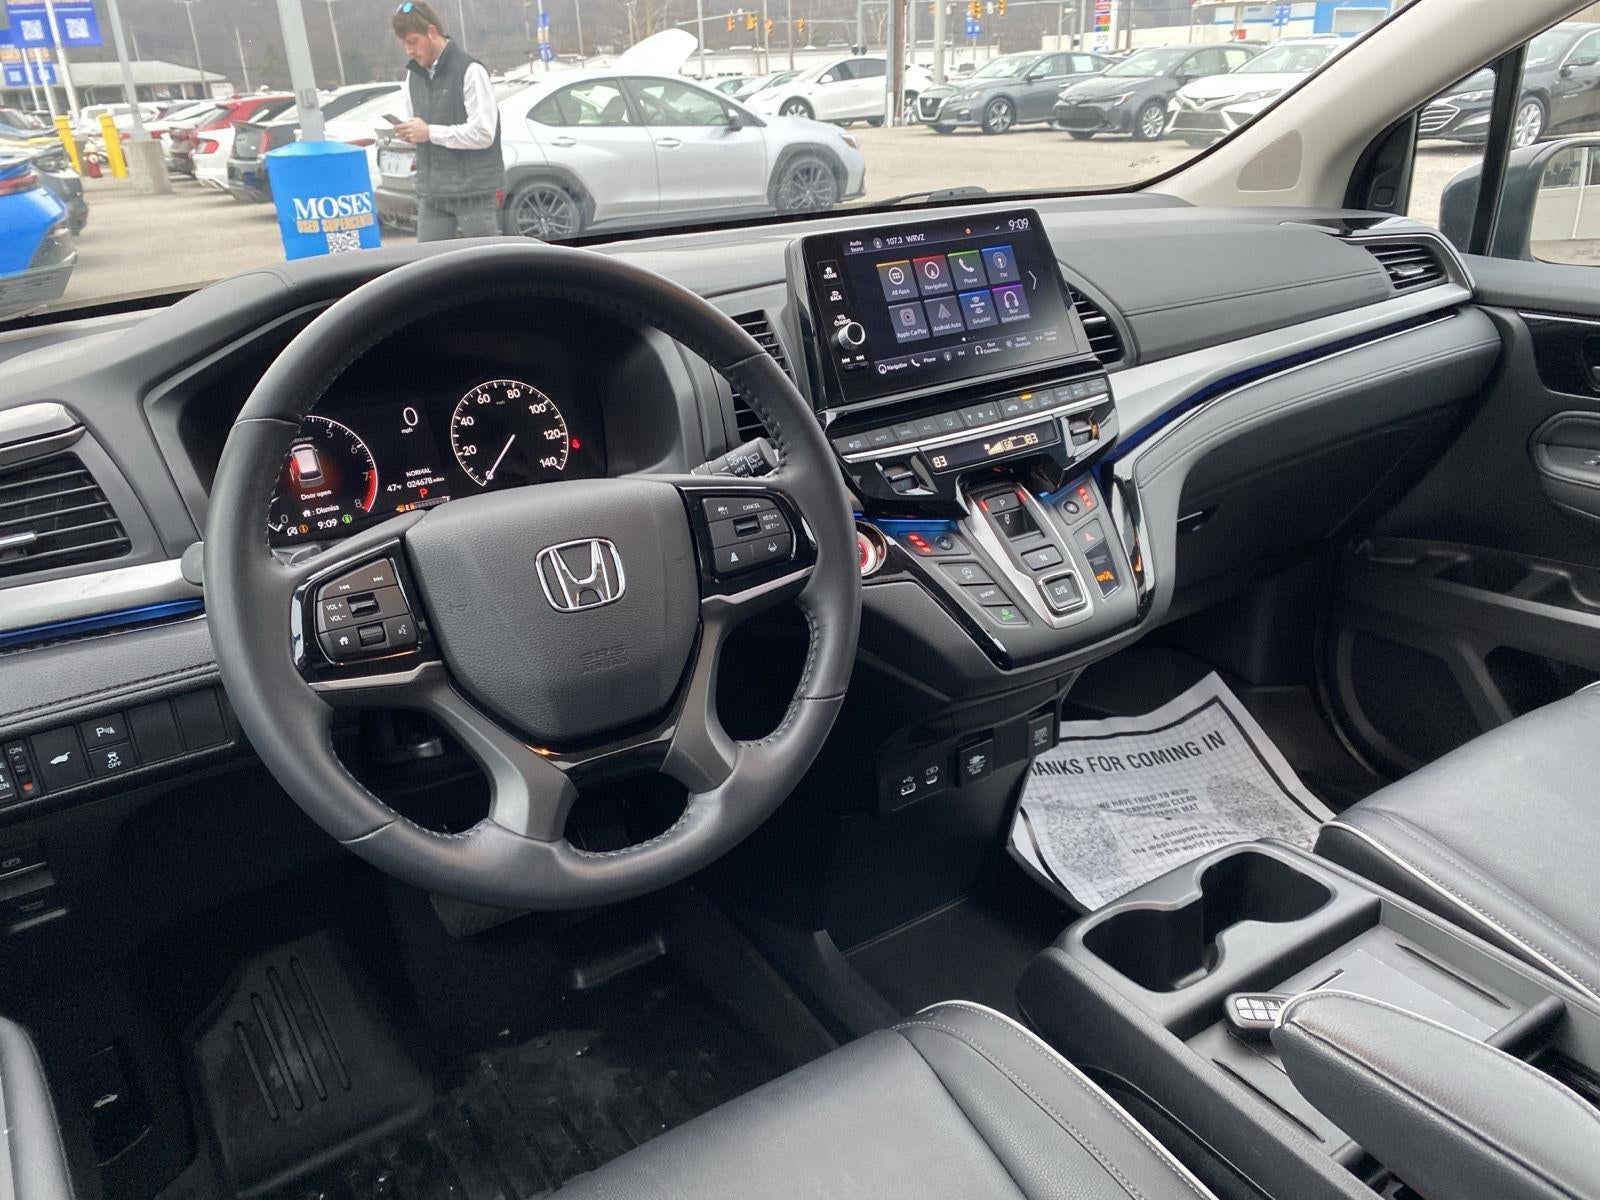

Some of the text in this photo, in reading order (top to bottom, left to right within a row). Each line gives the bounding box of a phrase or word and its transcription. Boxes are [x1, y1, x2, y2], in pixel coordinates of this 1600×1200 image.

[292, 192, 372, 220] MOSES
[1008, 217, 1029, 231] 9:09
[885, 233, 926, 245] 107.3 WRVZ
[925, 282, 949, 291] Navigation
[963, 277, 978, 285] Phone
[899, 288, 910, 296] Apps
[830, 294, 843, 302] BACK
[933, 321, 962, 332] Android Auto
[897, 328, 928, 339] Apple CarPlay
[477, 393, 491, 405] 60
[507, 388, 521, 399] 80
[529, 403, 547, 414] 100
[403, 407, 418, 426] 0
[460, 416, 474, 427] 40
[325, 429, 334, 439] 5
[544, 429, 561, 440] 120
[1024, 432, 1038, 444] 83
[350, 445, 358, 454] 6
[462, 444, 477, 456] 20
[540, 456, 558, 468] 140
[932, 455, 947, 468] 83
[361, 471, 369, 481] 7
[405, 468, 432, 477] NORMAL
[406, 477, 433, 488] 024678
[300, 489, 332, 500] Door open
[419, 488, 428, 498] P
[315, 504, 340, 515] Dismiss
[354, 499, 362, 509] 8
[742, 503, 761, 511] CANCEL
[280, 514, 289, 523] 0
[317, 519, 338, 530] 9:09
[1054, 585, 1068, 595] D/S
[9, 746, 22, 754] ON
[1031, 730, 1227, 777] ANKS FOR COMING IN
[107, 760, 122, 769] OFF
[1112, 798, 1132, 807] HAVE
[1134, 794, 1158, 804] TRIED
[1160, 791, 1169, 799] TO
[1171, 794, 1198, 806] CLEAN
[1182, 803, 1200, 812] MAT
[1161, 825, 1198, 839] customer
[1131, 847, 1146, 855] the
[1148, 841, 1169, 851] most
[1169, 831, 1211, 847] important
[1165, 846, 1180, 854] the
[1181, 841, 1205, 852] world
[1206, 839, 1215, 847] to
